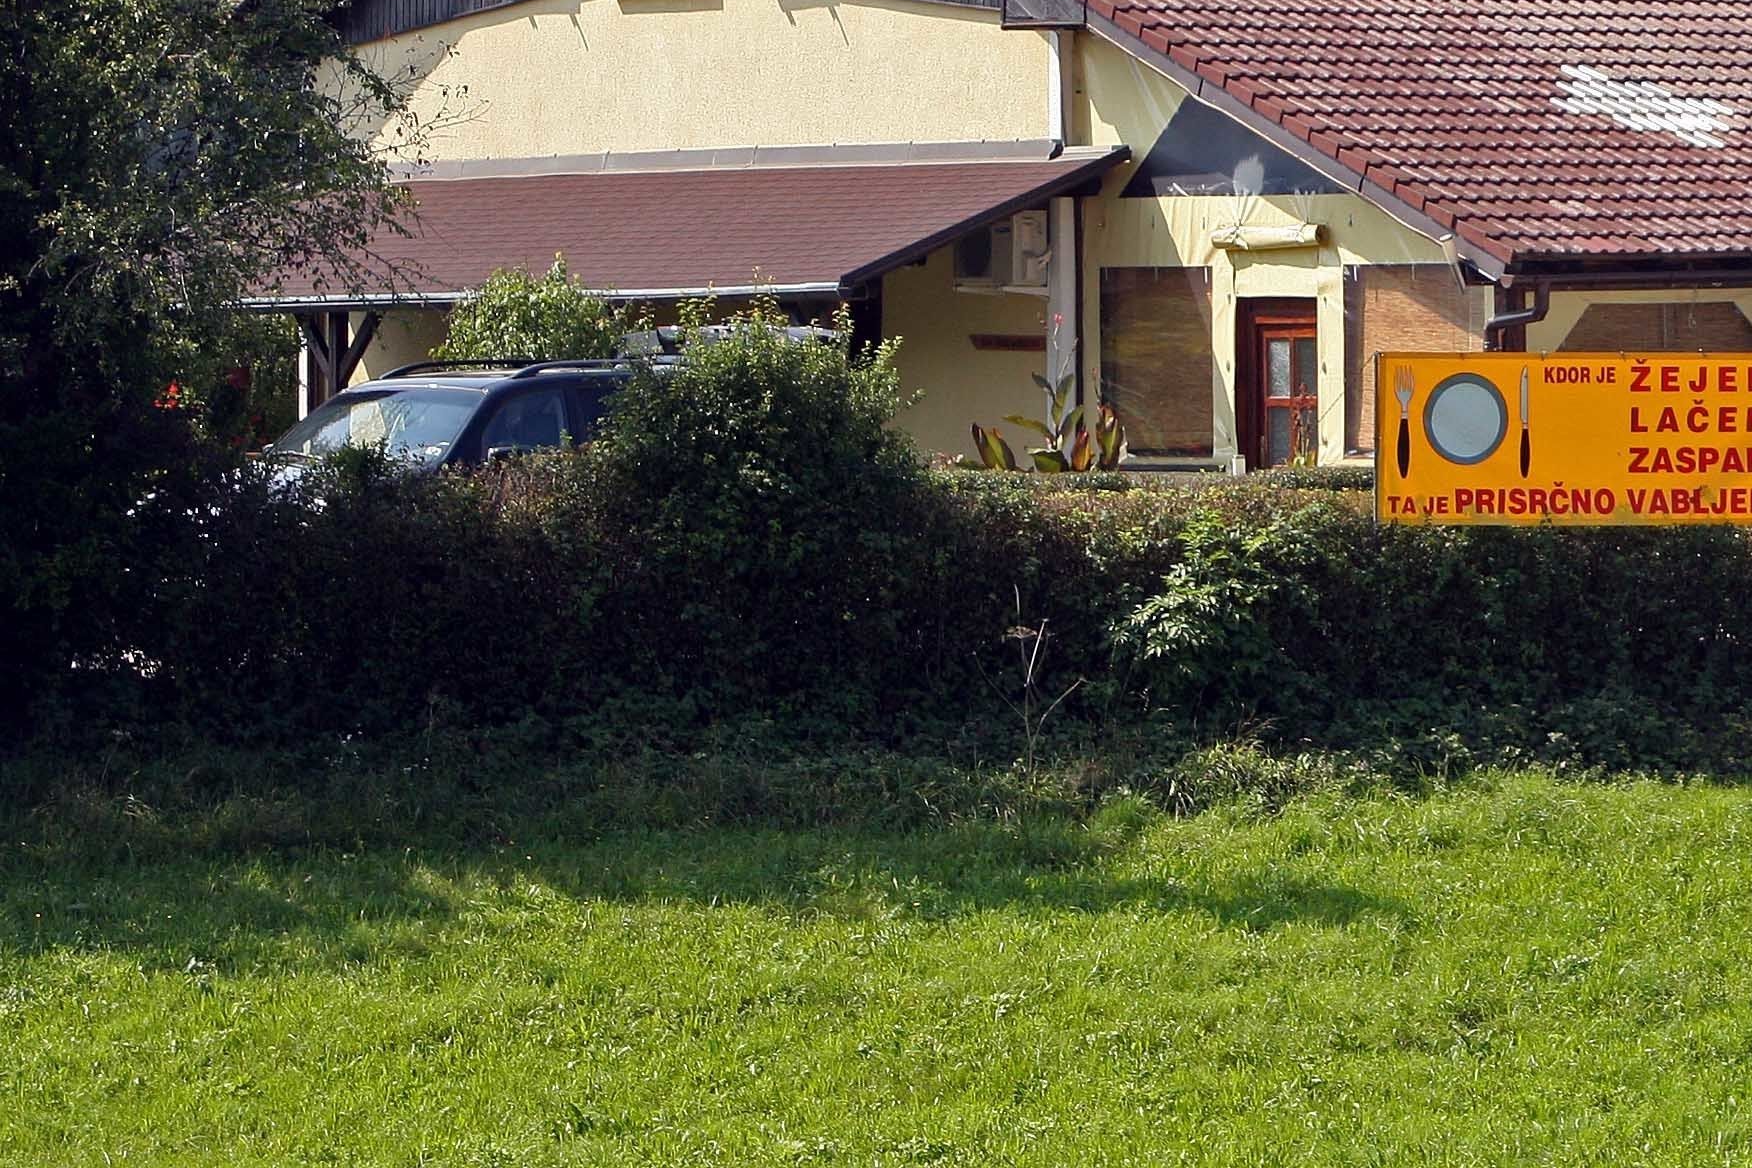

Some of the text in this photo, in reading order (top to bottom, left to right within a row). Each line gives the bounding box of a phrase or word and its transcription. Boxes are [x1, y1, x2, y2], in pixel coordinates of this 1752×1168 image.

[1544, 366, 1591, 384] KDOR
[1596, 366, 1616, 384] JE
[1387, 495, 1417, 514] TA
[1423, 496, 1449, 515] JE
[1454, 481, 1617, 515] PRISRČNO
